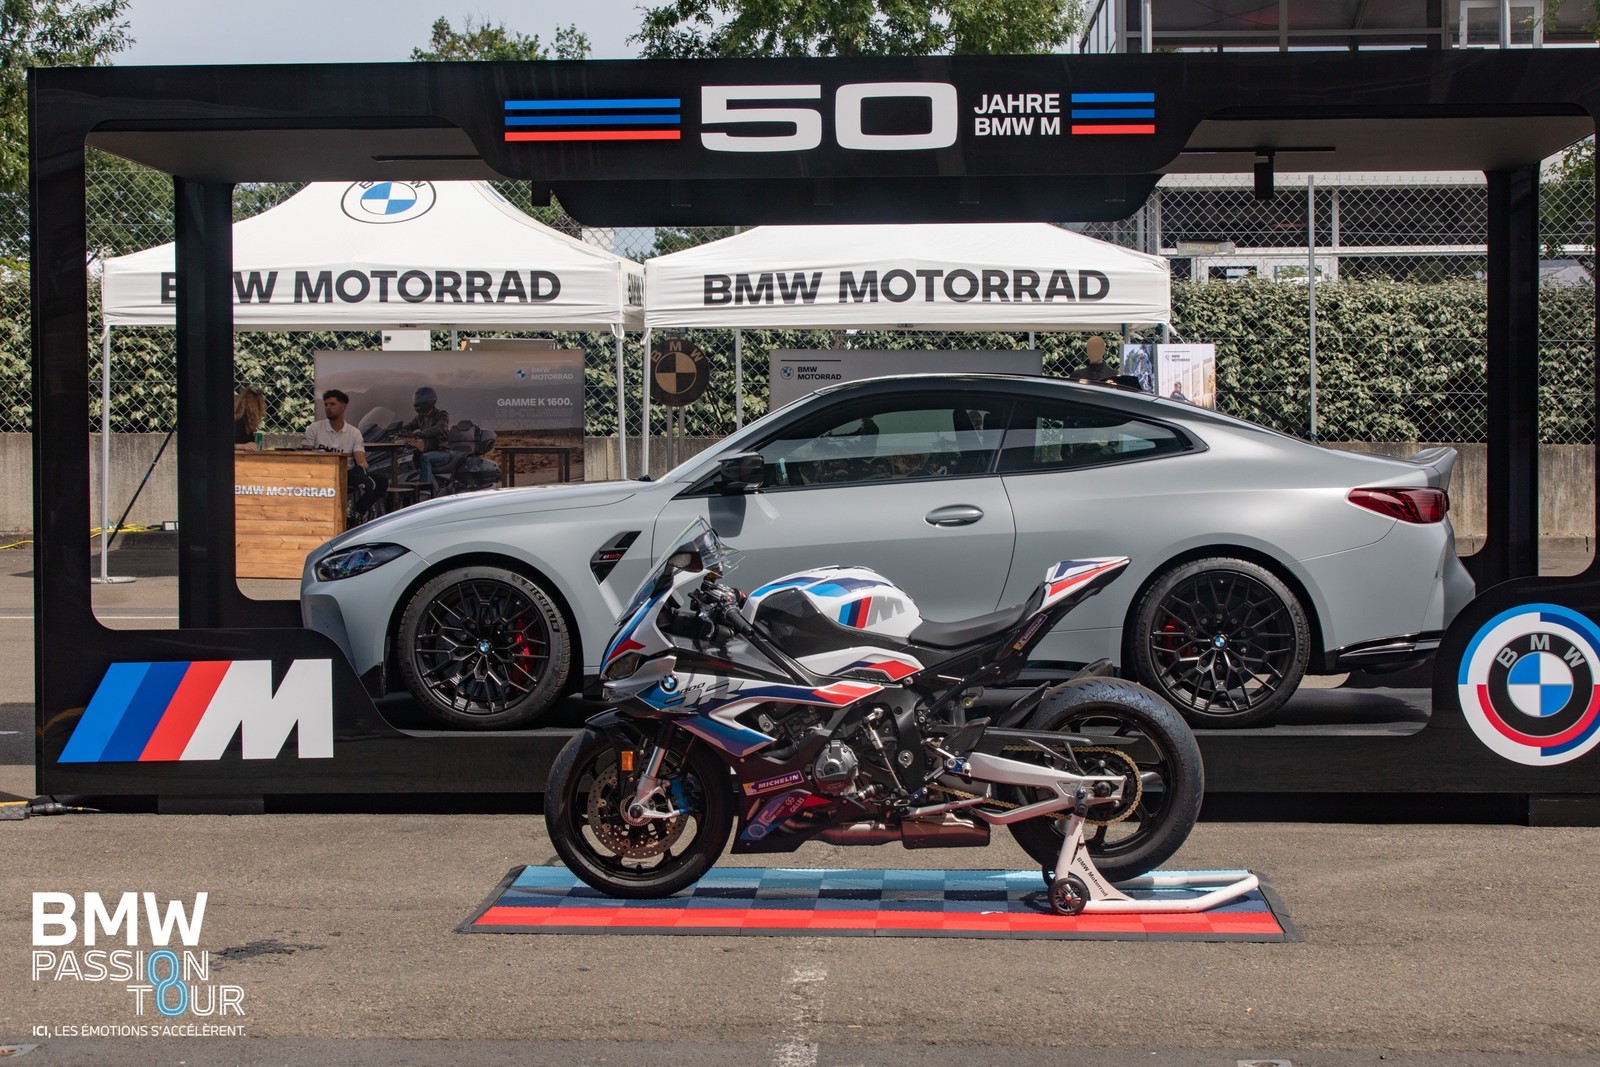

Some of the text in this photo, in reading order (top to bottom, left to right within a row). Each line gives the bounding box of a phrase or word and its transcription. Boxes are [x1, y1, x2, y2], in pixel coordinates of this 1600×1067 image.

[974, 93, 1060, 114] JAHRE
[701, 82, 958, 152] 50
[975, 117, 1060, 136] BMW M
[294, 269, 561, 303] MOTORRAD
[704, 268, 1110, 305] BMW MOTORRAD
[650, 341, 704, 364] BMW
[496, 397, 573, 407] GAMME K 1600.
[235, 485, 336, 498] BMW MOTORRAD
[1496, 634, 1585, 669] BMW
[758, 774, 799, 789] MICHELIN
[1076, 857, 1109, 897] BMW Motorrad
